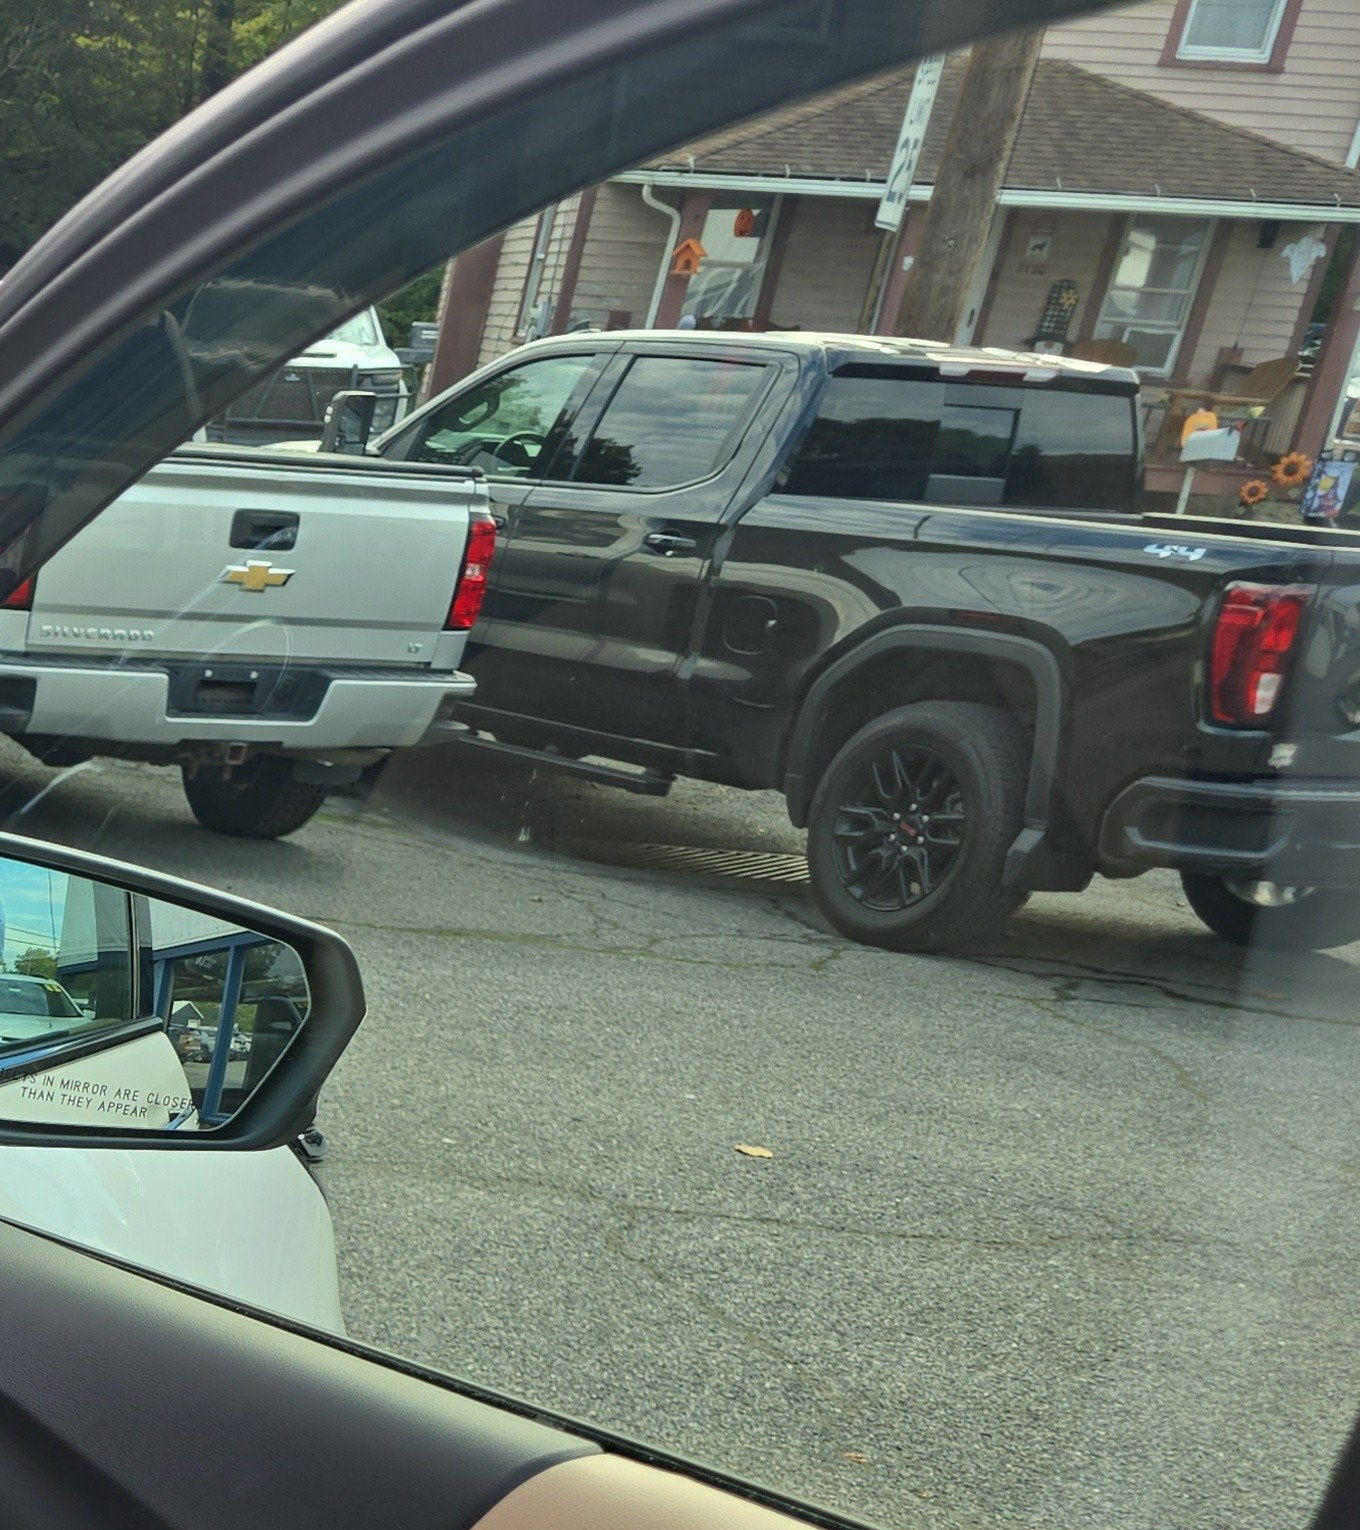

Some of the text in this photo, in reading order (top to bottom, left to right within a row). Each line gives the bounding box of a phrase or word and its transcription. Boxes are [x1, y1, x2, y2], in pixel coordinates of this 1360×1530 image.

[41, 624, 155, 641] SILVERADO
[21, 1086, 148, 1118] THAN THEY APPEAR
[42, 1074, 55, 1086] IN
[59, 1078, 108, 1097] MIRROR
[114, 1087, 140, 1102] ARE
